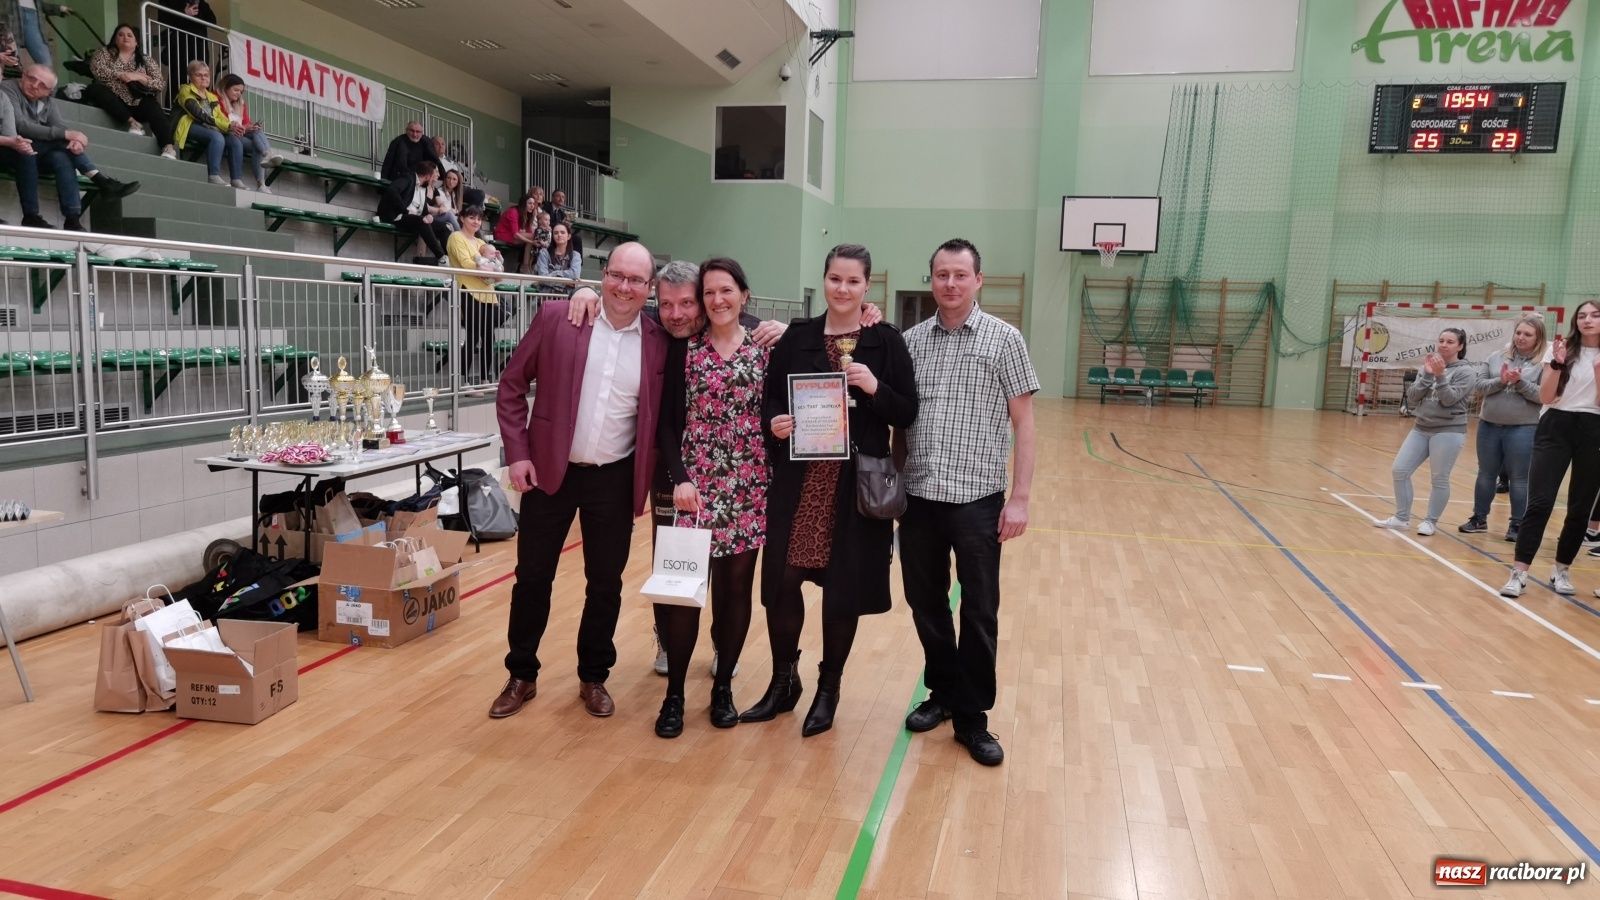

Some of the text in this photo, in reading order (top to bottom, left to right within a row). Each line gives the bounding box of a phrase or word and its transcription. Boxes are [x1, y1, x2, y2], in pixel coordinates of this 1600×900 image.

[1351, 0, 1575, 63] Arena
[245, 39, 370, 114] LUNATYCY
[1412, 98, 1421, 109] 2
[1444, 92, 1489, 108] 19:54
[1518, 97, 1523, 107] 1
[1411, 119, 1457, 128] GOSPODARZE
[1481, 117, 1509, 128] GOŚCIE
[1460, 124, 1468, 133] 4
[1414, 133, 1438, 148] 25
[1491, 133, 1517, 148] 23
[1395, 347, 1422, 361] JEST
[1425, 344, 1436, 353] W
[796, 382, 840, 390] DYPLOM
[421, 586, 456, 616] JAKO
[191, 683, 203, 691] REF
[205, 685, 217, 693] NO:
[191, 697, 217, 706] QTY: 12
